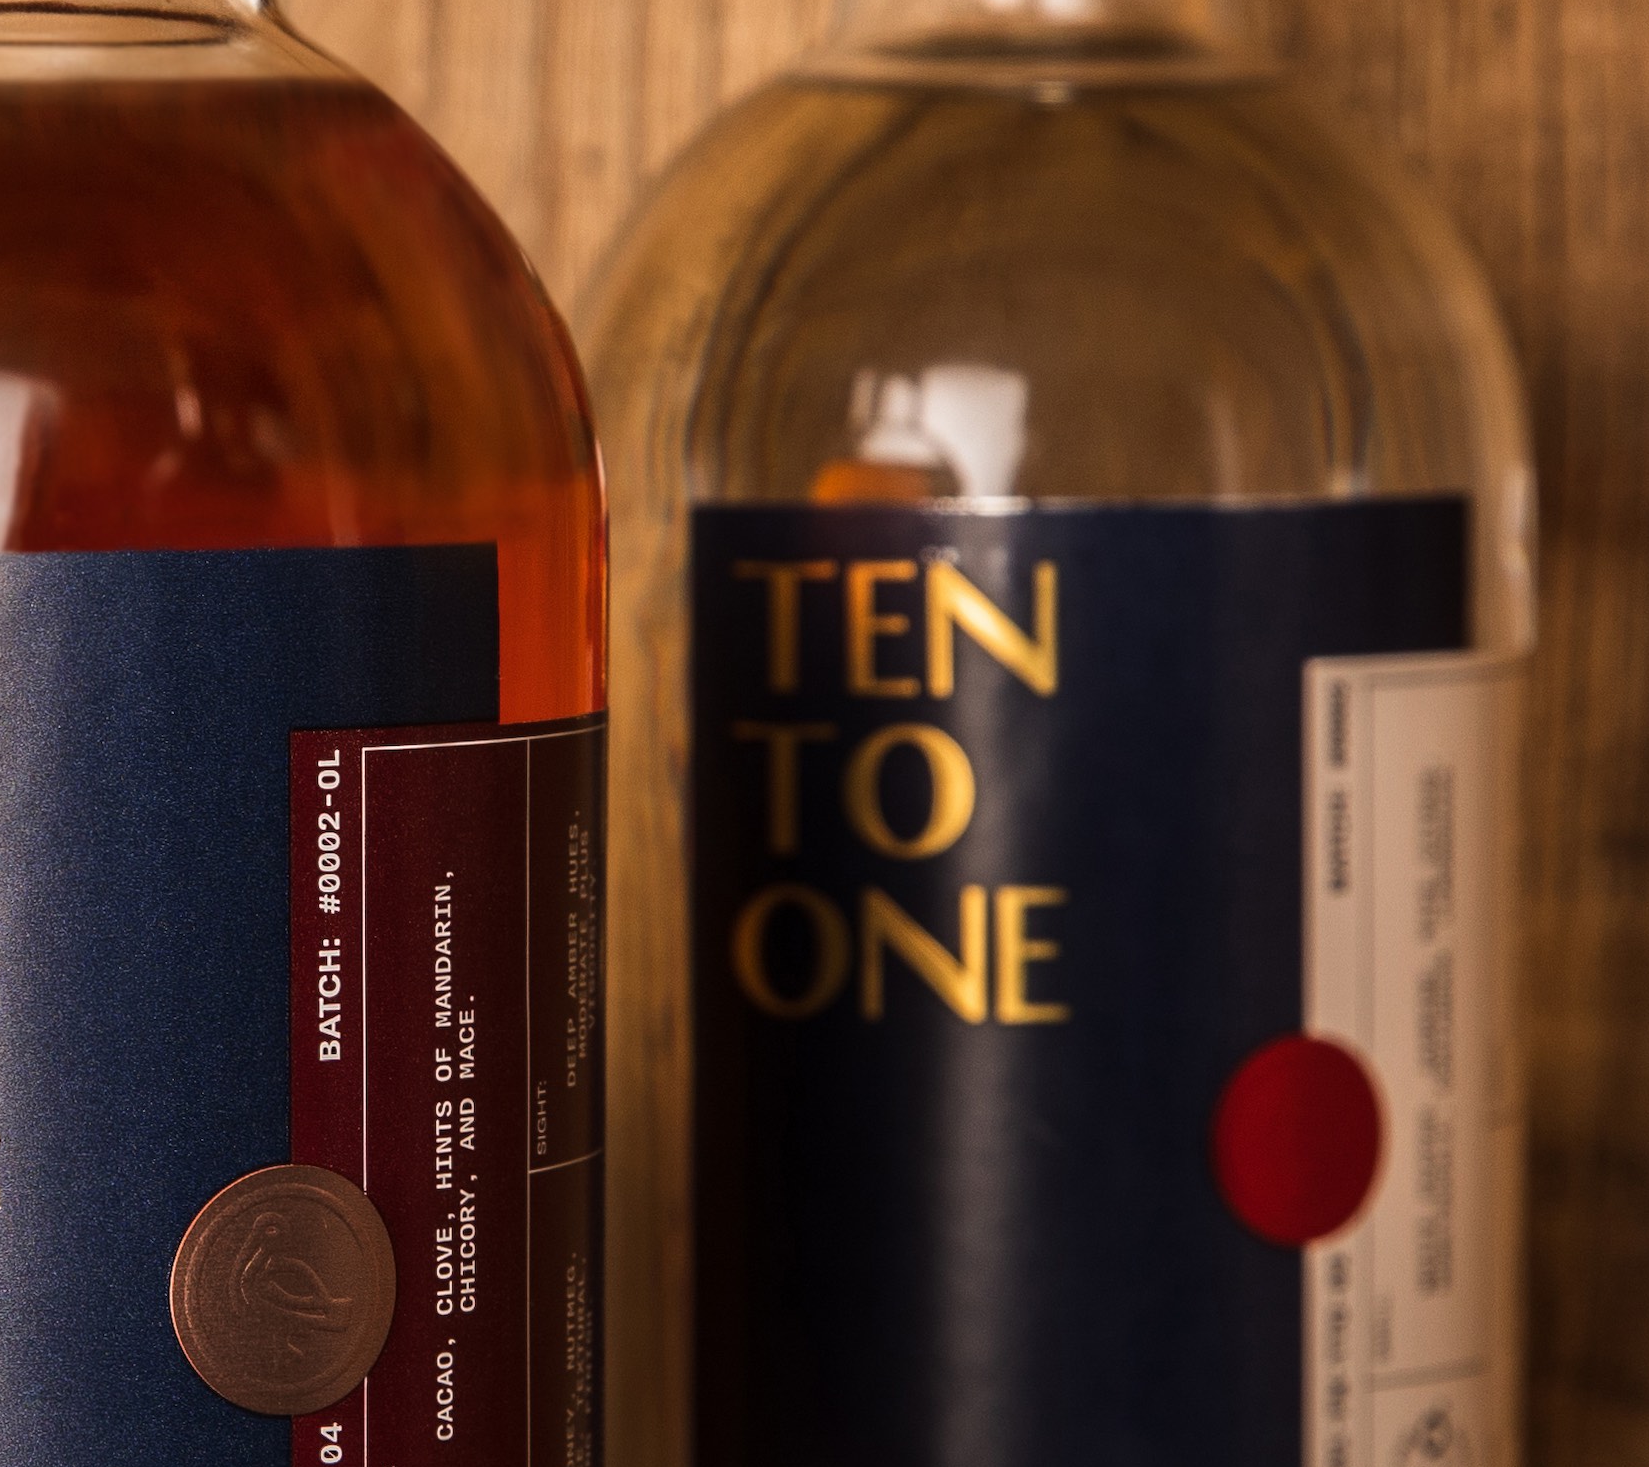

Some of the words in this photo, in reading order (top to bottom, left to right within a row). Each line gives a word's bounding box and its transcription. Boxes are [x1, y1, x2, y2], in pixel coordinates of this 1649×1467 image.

[732, 559, 1059, 698] TEN
[732, 722, 976, 860] TO
[580, 830, 588, 899] PLUS
[435, 871, 454, 1027] MANDARIN,
[568, 912, 578, 998] AMBER
[579, 920, 588, 1058] MODERATE
[732, 884, 1071, 1025] ONE
[318, 939, 341, 1061] BATCH:
[459, 996, 475, 1079] MACE.
[435, 1048, 452, 1082] OF
[567, 1019, 577, 1086] DEEP
[436, 1100, 452, 1189] HINTS
[460, 1098, 475, 1150] AND
[537, 1081, 546, 1156] SIGHT:
[437, 1213, 455, 1315] CLOVE,
[460, 1174, 478, 1312] CHICORY,
[437, 1339, 456, 1440] CACAO,
